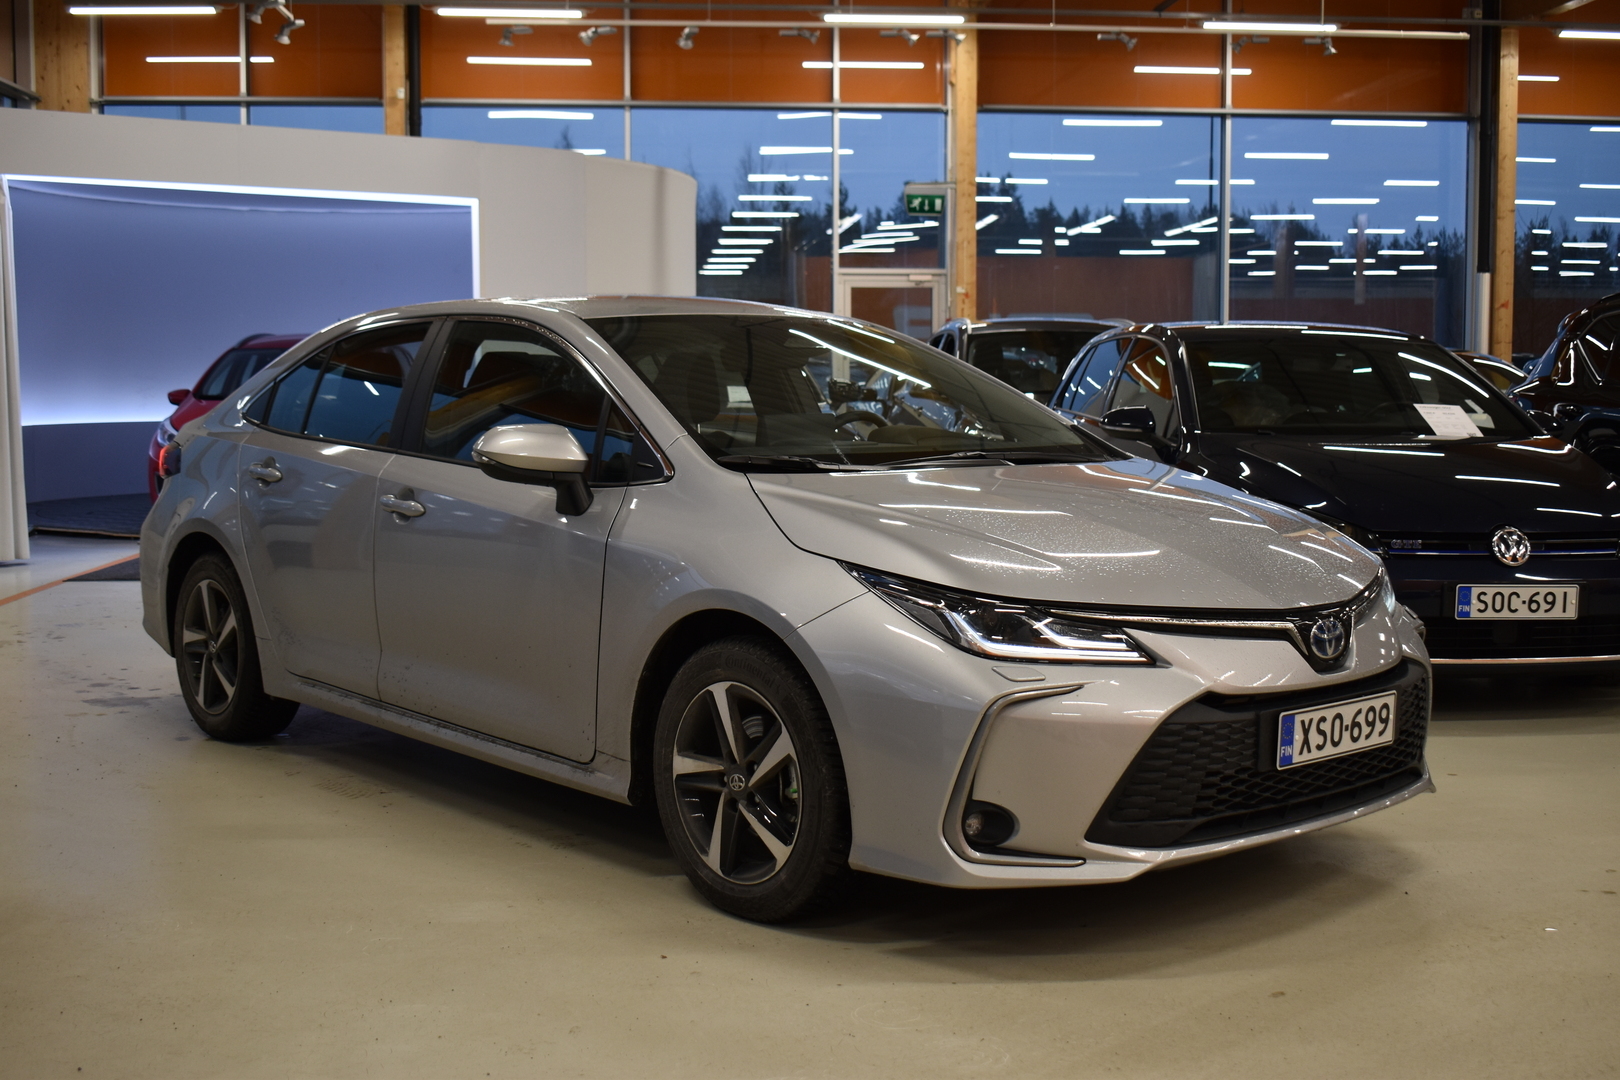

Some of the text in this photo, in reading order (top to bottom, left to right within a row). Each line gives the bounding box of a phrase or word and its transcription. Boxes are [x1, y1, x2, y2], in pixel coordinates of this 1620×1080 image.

[1390, 539, 1422, 549] GTE
[1458, 604, 1471, 612] FIN
[1476, 591, 1568, 613] SOC-691
[1298, 702, 1390, 755] XSO-699
[1280, 744, 1293, 757] FIN
